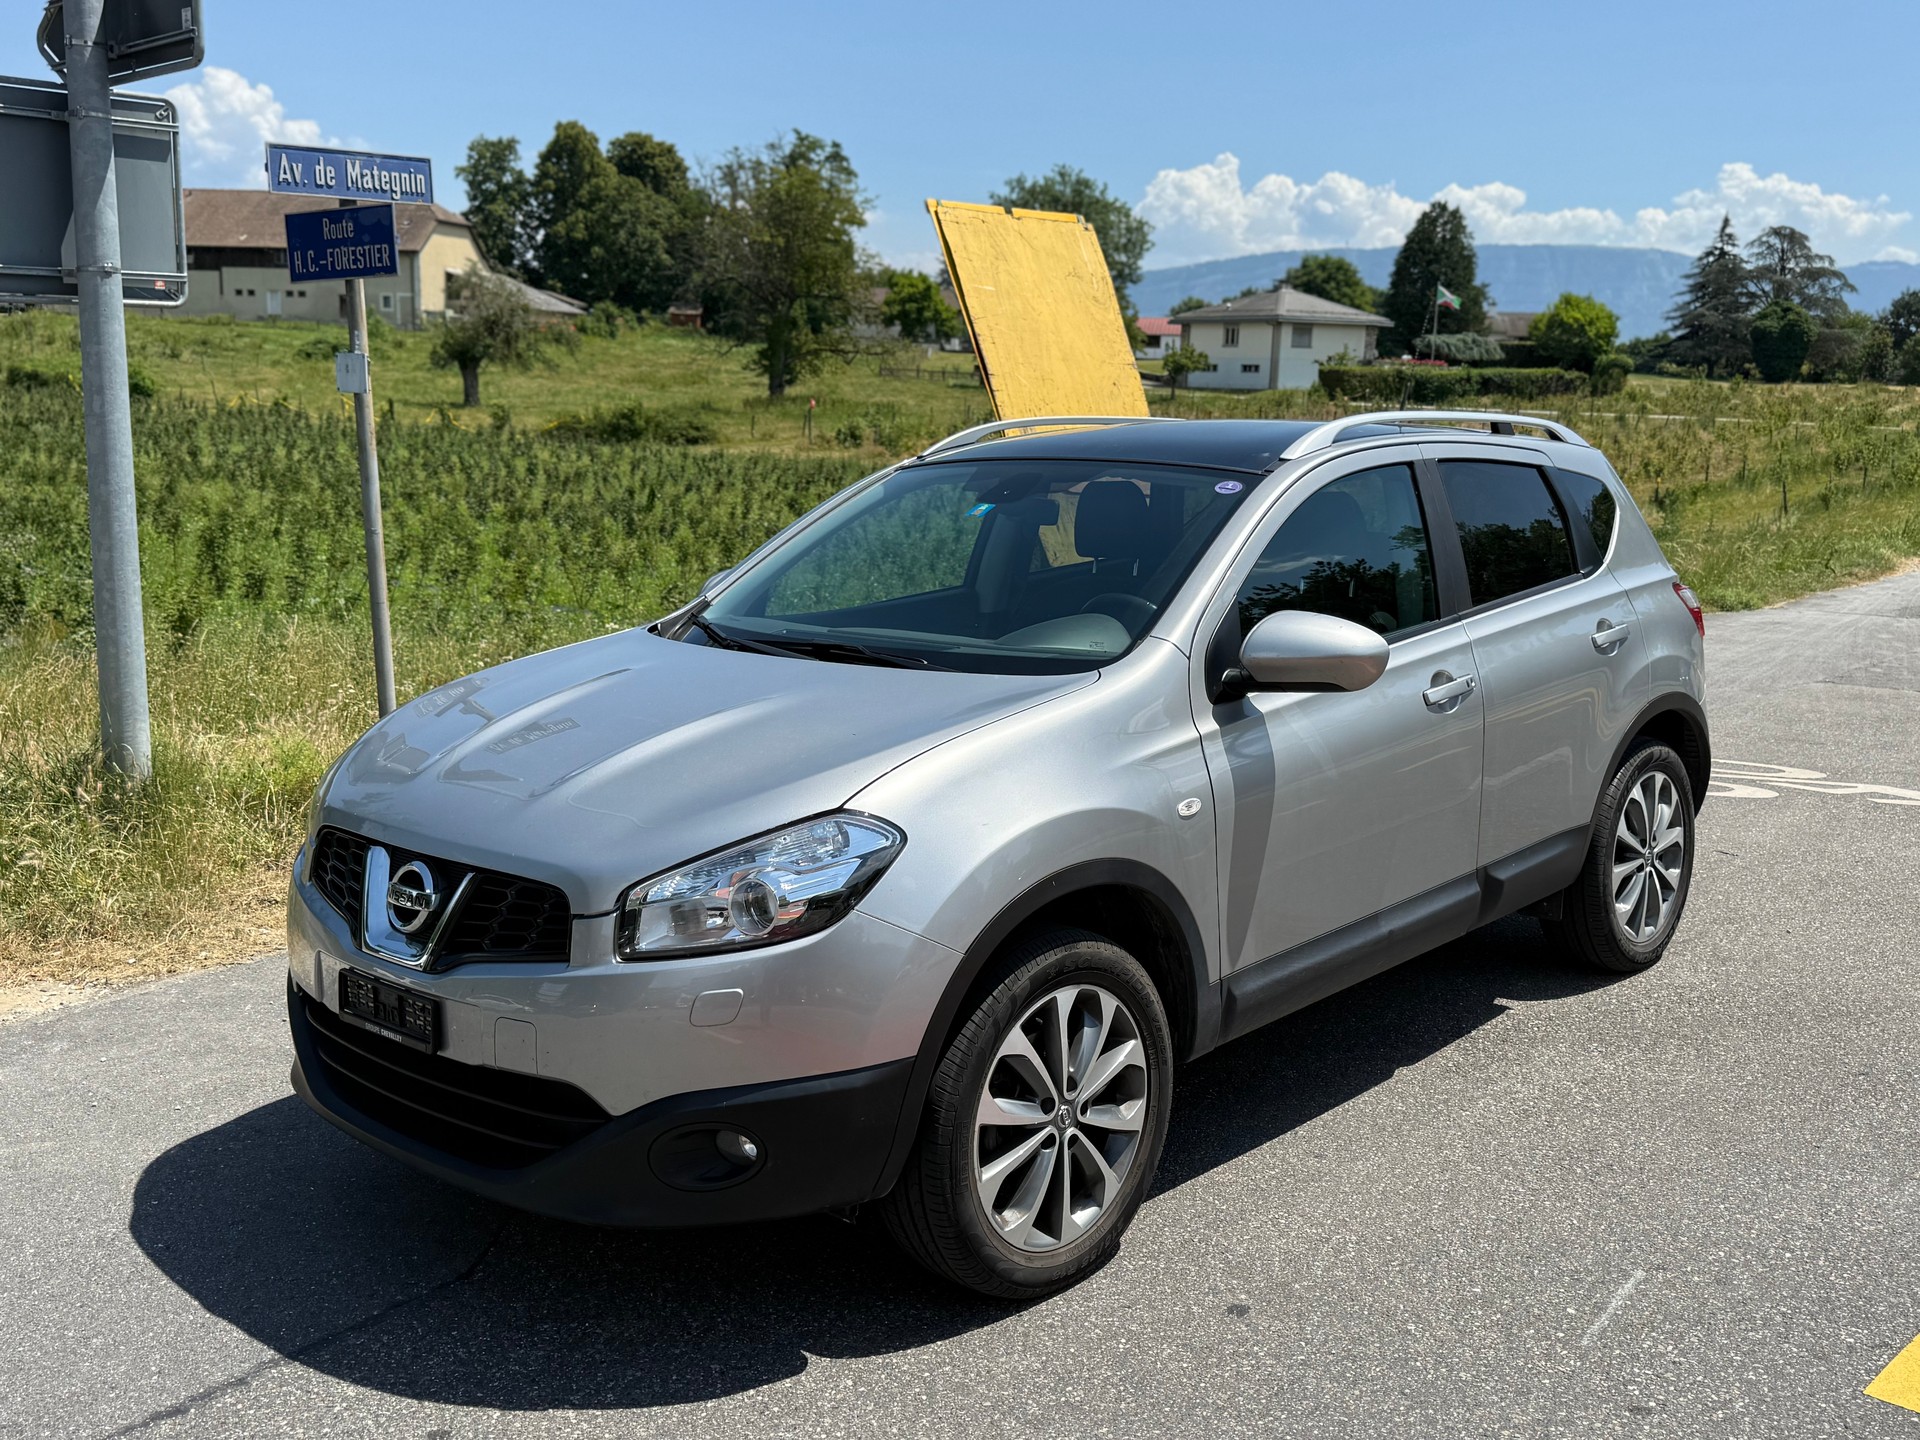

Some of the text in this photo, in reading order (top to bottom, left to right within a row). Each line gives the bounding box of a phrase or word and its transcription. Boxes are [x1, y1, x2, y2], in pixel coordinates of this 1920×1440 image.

[279, 153, 425, 200] Av. de Mategnin
[322, 217, 355, 241] Route
